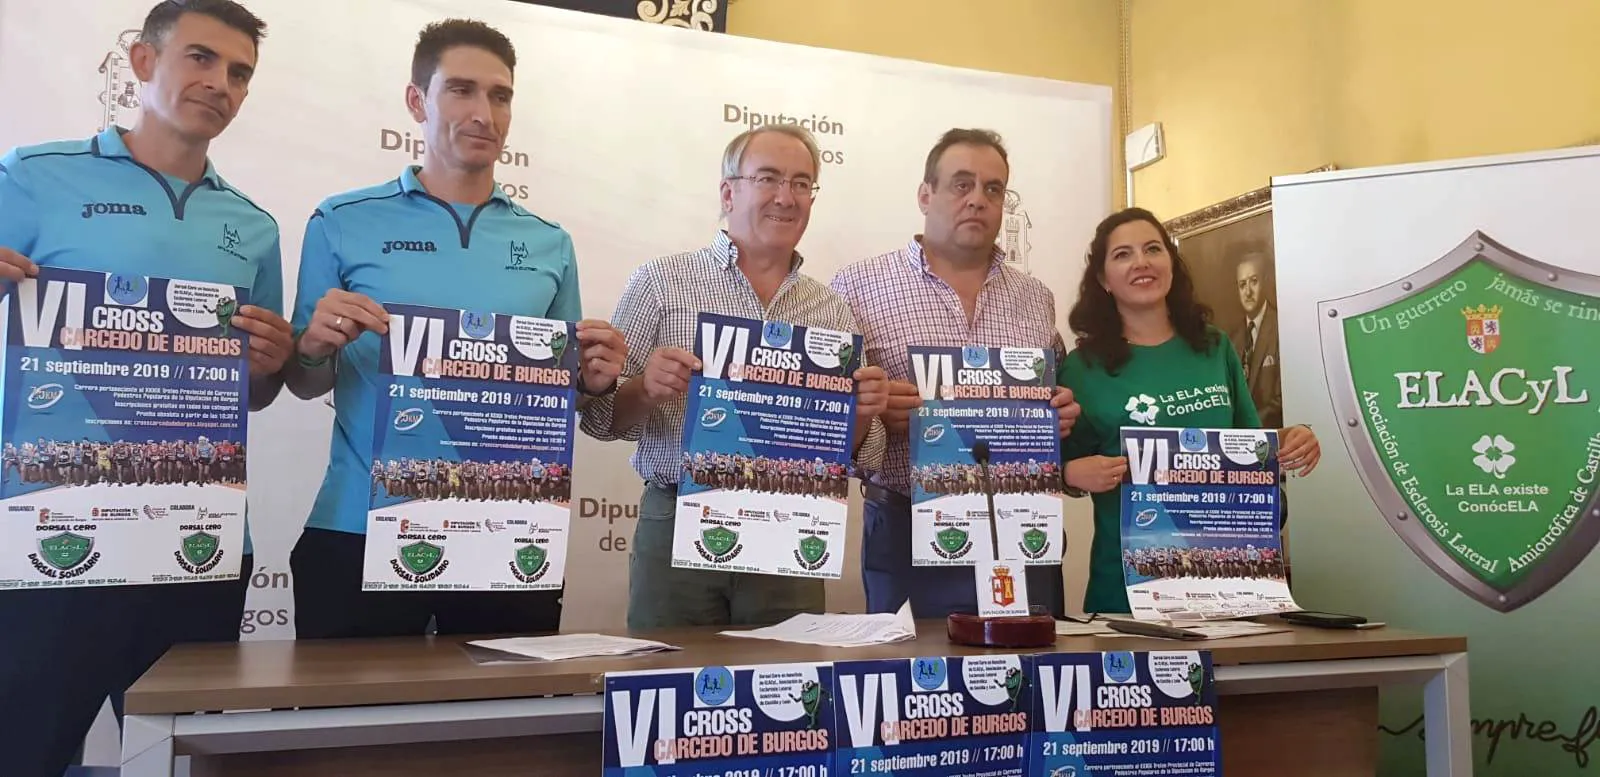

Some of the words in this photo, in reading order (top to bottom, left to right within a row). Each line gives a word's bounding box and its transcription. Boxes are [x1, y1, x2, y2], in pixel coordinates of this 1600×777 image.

[1356, 315, 1392, 334] Un
[1397, 280, 1467, 329] guerrero
[1485, 273, 1540, 308] jamás
[1543, 300, 1562, 314] se
[17, 278, 87, 350] VI
[92, 307, 164, 333] CROSS
[60, 327, 142, 350] CARCEDO
[147, 333, 168, 352] DE
[173, 335, 241, 356] BURGOS
[389, 315, 444, 379] VI
[450, 339, 508, 364] CROSS
[702, 322, 750, 382] VI
[20, 357, 39, 372] 21
[46, 359, 129, 377] septiembre
[133, 364, 170, 379] 2019
[188, 366, 228, 380] 17:00
[232, 368, 239, 382] h
[422, 358, 490, 380] CARCEDO
[494, 364, 512, 381] DE
[516, 366, 570, 386] BURGOS
[752, 347, 802, 371] CROSS
[728, 362, 784, 384] CARCEDO
[788, 370, 803, 387] DE
[806, 373, 853, 393] BURGOS
[912, 353, 954, 400] VI
[958, 369, 1002, 385] CROSS
[1394, 365, 1589, 415] ELACyL
[390, 384, 404, 398] 21
[409, 388, 478, 402] septiembre
[482, 392, 511, 406] 2019
[526, 394, 558, 408] 17:00
[561, 396, 568, 410] h
[699, 385, 712, 398] 21
[716, 388, 773, 405] septiembre
[776, 395, 802, 408] 2019
[814, 400, 842, 413] 17:00
[844, 402, 850, 414] h
[940, 384, 990, 398] CARCEDO
[993, 386, 1007, 398] DE
[1009, 386, 1052, 400] BURGOS
[1159, 394, 1175, 404] La
[1176, 387, 1203, 401] ELA
[918, 407, 930, 417] 21
[932, 407, 984, 418] septiembre
[986, 407, 1009, 418] 2019
[1020, 408, 1044, 418] 17:00
[1046, 408, 1052, 418] h
[1125, 438, 1169, 486] VI
[1174, 453, 1221, 470] CROSS
[1154, 469, 1207, 485] CARCEDO
[1210, 470, 1226, 484] DE
[1227, 470, 1274, 485] BURGOS
[1362, 390, 1400, 459] Asociación
[1393, 458, 1409, 478] de
[1402, 476, 1450, 538] Esclerosis
[1448, 532, 1499, 574] Lateral
[1446, 484, 1465, 496] La
[1468, 484, 1499, 496] ELA
[1502, 483, 1549, 496] existe
[1130, 490, 1142, 502] 21
[1146, 492, 1200, 504] septiembre
[1201, 492, 1226, 504] 2019
[1238, 493, 1265, 504] 17:00
[1268, 494, 1274, 505] h
[1458, 499, 1539, 513] ConócELA
[599, 530, 627, 552] de
[1508, 504, 1580, 573] Amiotrófica
[1569, 486, 1588, 503] de
[28, 552, 57, 578] DORSAL
[58, 552, 101, 579] SOLIDARIO
[174, 550, 194, 574] DORSAL
[194, 549, 224, 574] SOLIDARIO
[390, 558, 413, 582] DORSAL
[414, 560, 449, 583] SOLIDARIO
[839, 672, 900, 749] VI
[904, 692, 964, 720] CROSS
[1038, 664, 1092, 733] VI
[1096, 684, 1152, 710] CROSS
[611, 687, 676, 768] VI
[683, 706, 752, 737] CROSS
[880, 718, 948, 742] CARCEDO
[952, 716, 969, 737] DE
[972, 712, 1027, 735] BURGOS
[1074, 708, 1137, 729] CARCEDO
[1140, 708, 1158, 726] DE
[1160, 706, 1214, 726] BURGOS
[654, 734, 734, 761] CARCEDO
[738, 733, 758, 756] DE
[762, 728, 828, 754] BURGOS
[1043, 741, 1057, 756] 21
[1062, 740, 1128, 757] septiembre
[1130, 740, 1159, 754] 2019
[1174, 738, 1205, 752] 17:00
[1208, 738, 1214, 750] h
[851, 758, 866, 774] 21
[870, 753, 937, 774] septiembre
[940, 750, 970, 766] 2019
[984, 745, 1014, 762] 17:00
[1016, 744, 1024, 758] h
